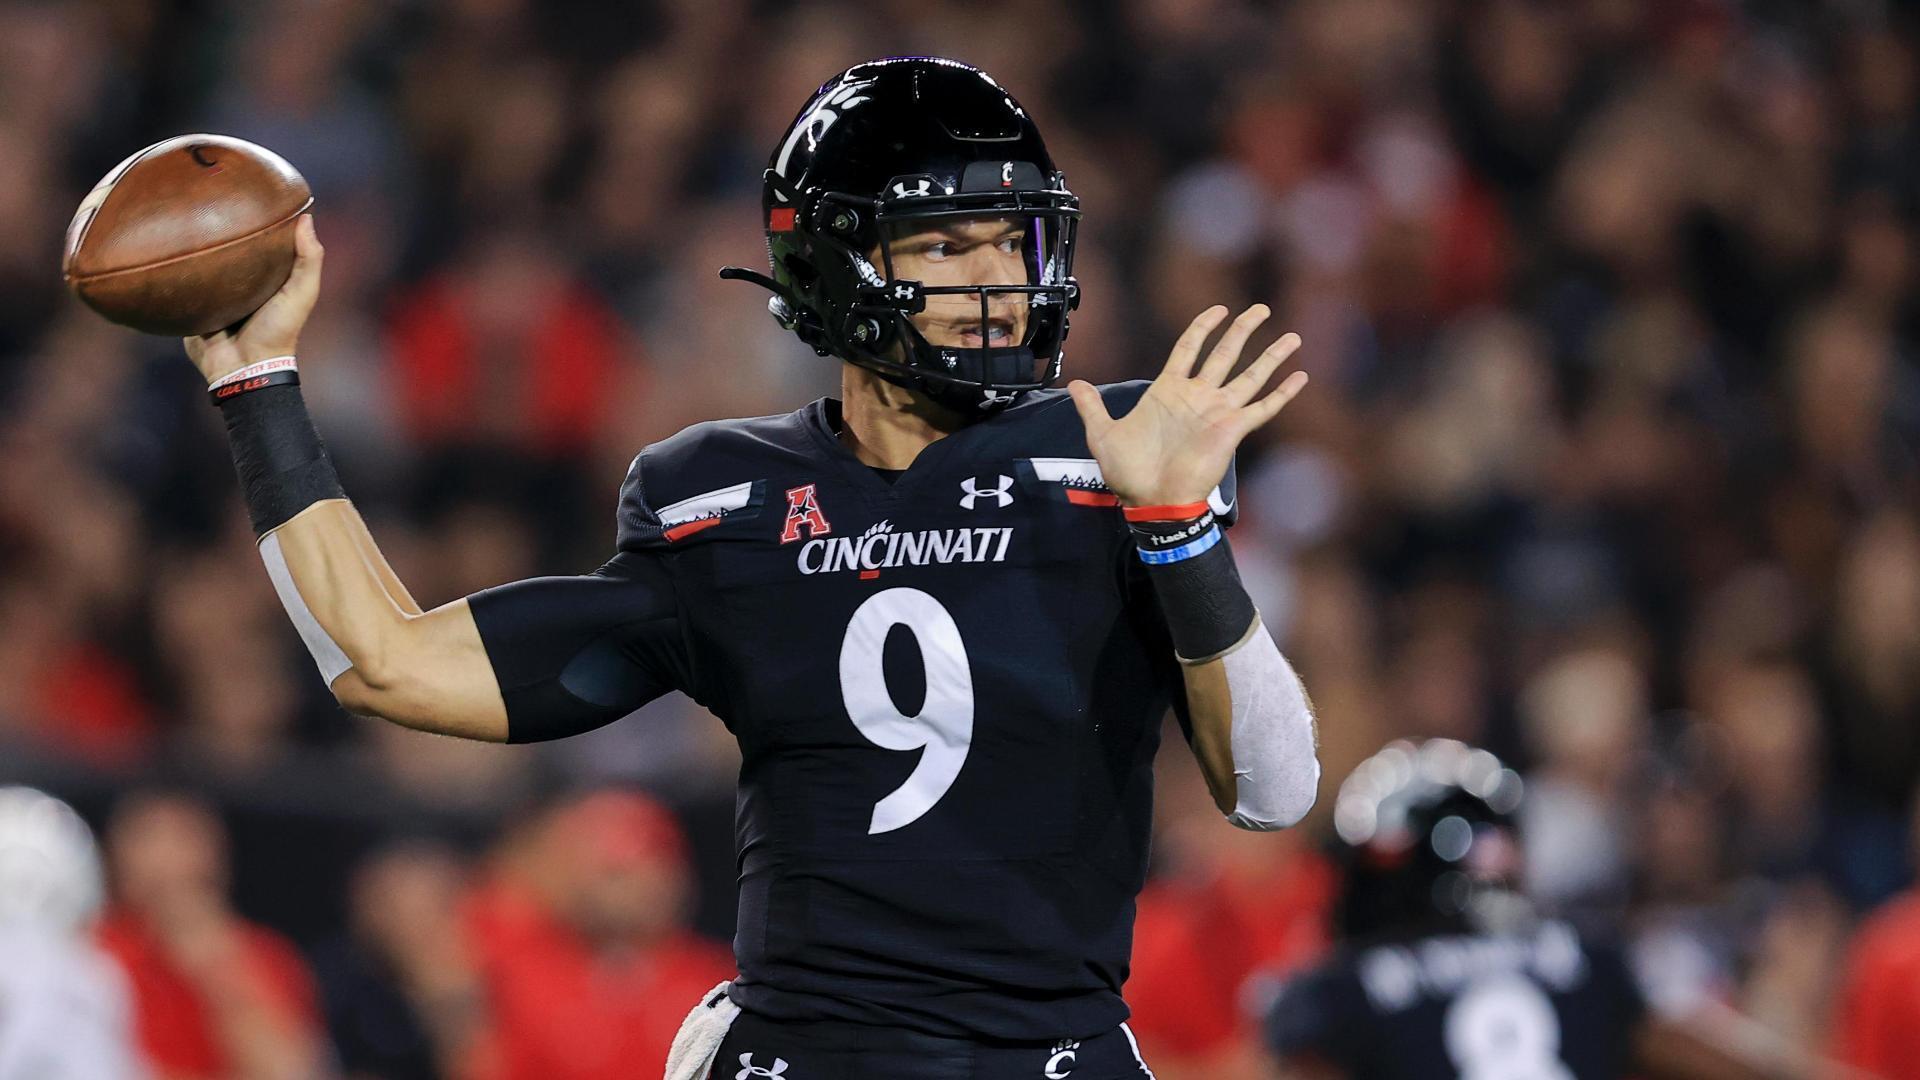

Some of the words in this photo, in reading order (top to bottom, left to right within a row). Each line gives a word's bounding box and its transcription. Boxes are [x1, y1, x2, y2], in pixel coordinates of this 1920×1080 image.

[797, 524, 1014, 576] CINCINNATI
[1159, 530, 1188, 544] Lack
[839, 587, 974, 834] 9
